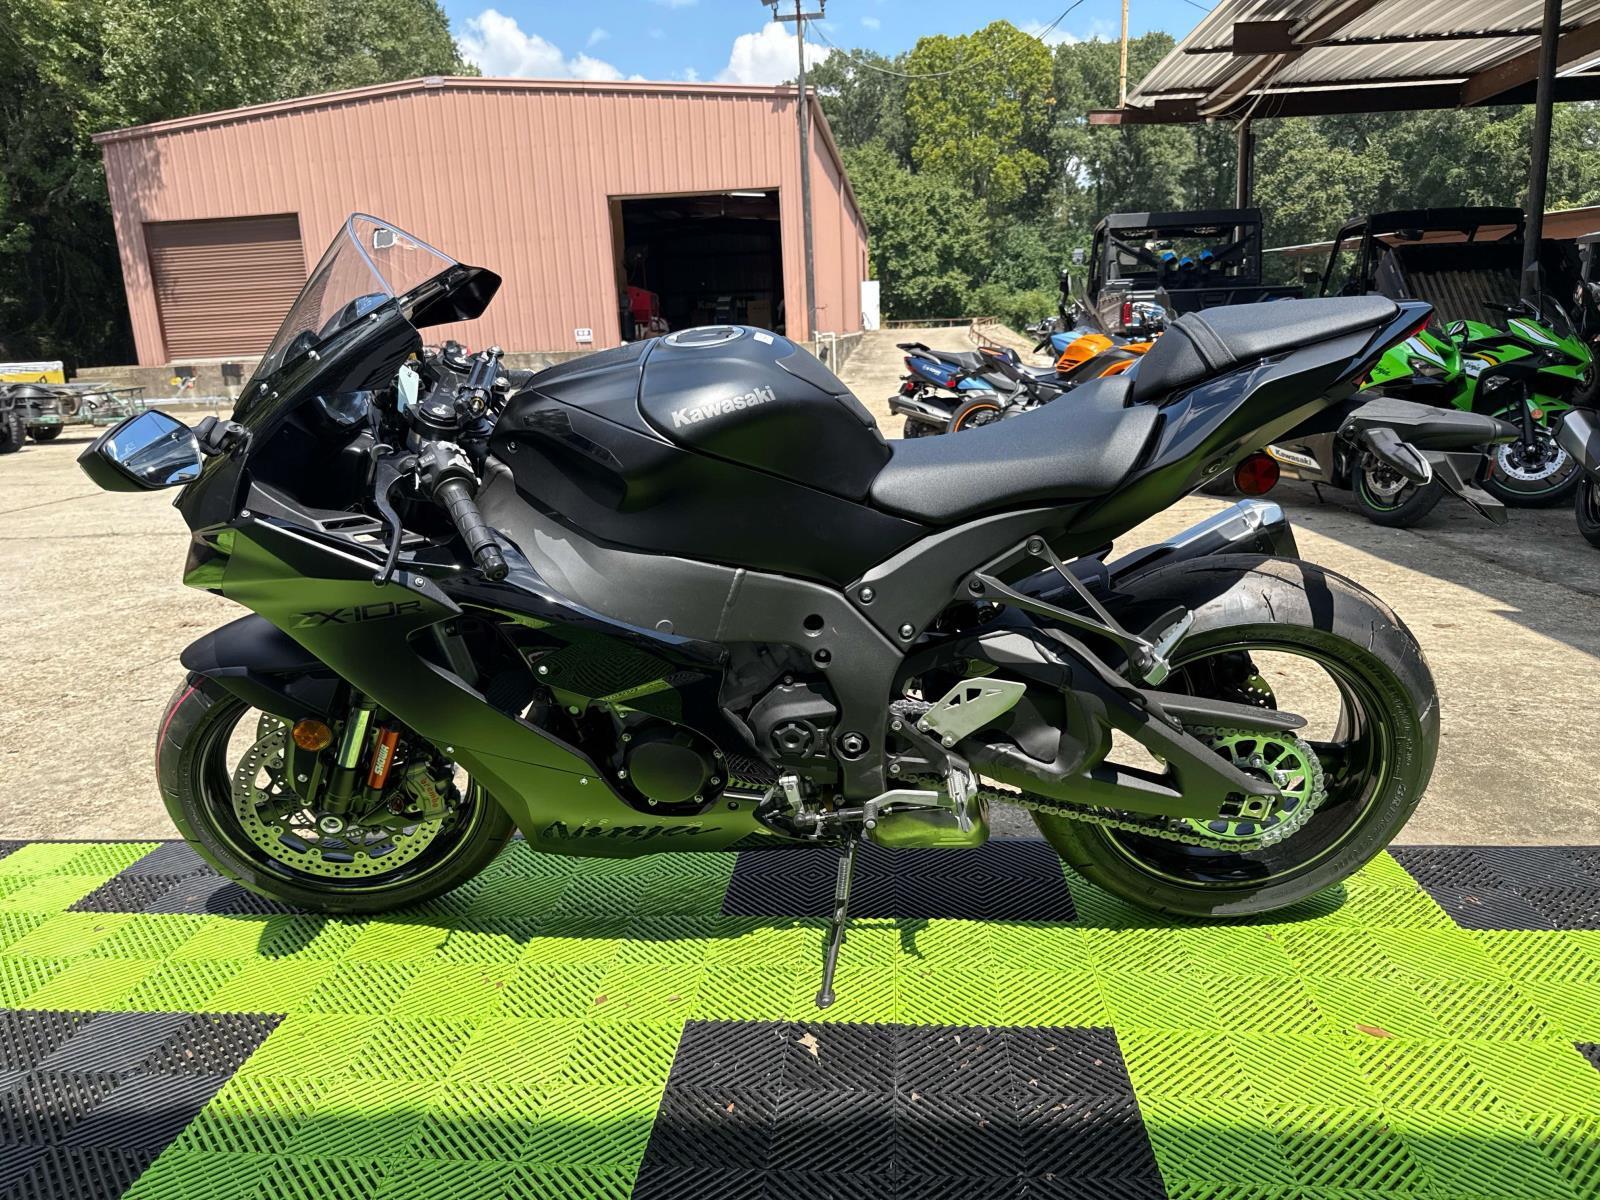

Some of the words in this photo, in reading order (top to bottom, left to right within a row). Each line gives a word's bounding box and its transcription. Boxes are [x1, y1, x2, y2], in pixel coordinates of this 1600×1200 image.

[671, 385, 776, 428] Kawasaki
[1275, 448, 1312, 466] Kawasaki
[289, 600, 424, 629] ZX-10R
[374, 743, 390, 776] SHOWA
[421, 777, 440, 809] brembo
[541, 818, 723, 845] Ninja
